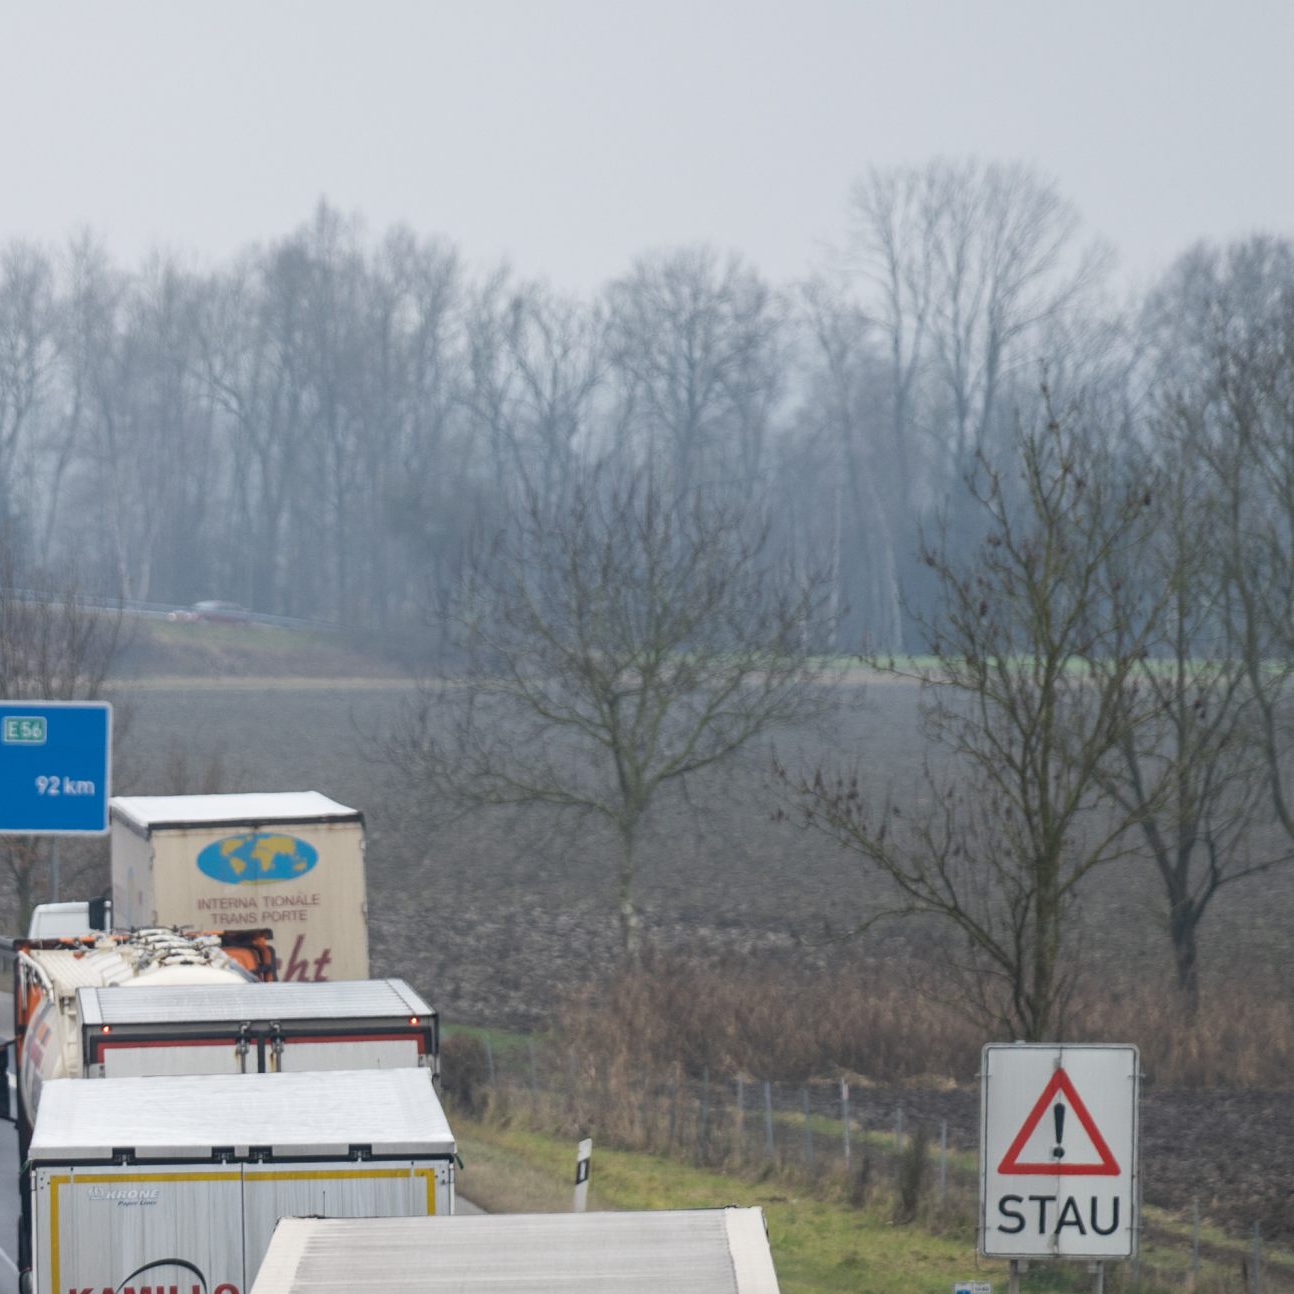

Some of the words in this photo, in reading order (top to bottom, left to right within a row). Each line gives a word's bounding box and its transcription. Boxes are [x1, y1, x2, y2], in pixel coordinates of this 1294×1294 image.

[34, 775, 60, 796] 92
[63, 776, 95, 796] km
[106, 1189, 160, 1199] KRONE
[997, 1194, 1119, 1236] STAU
